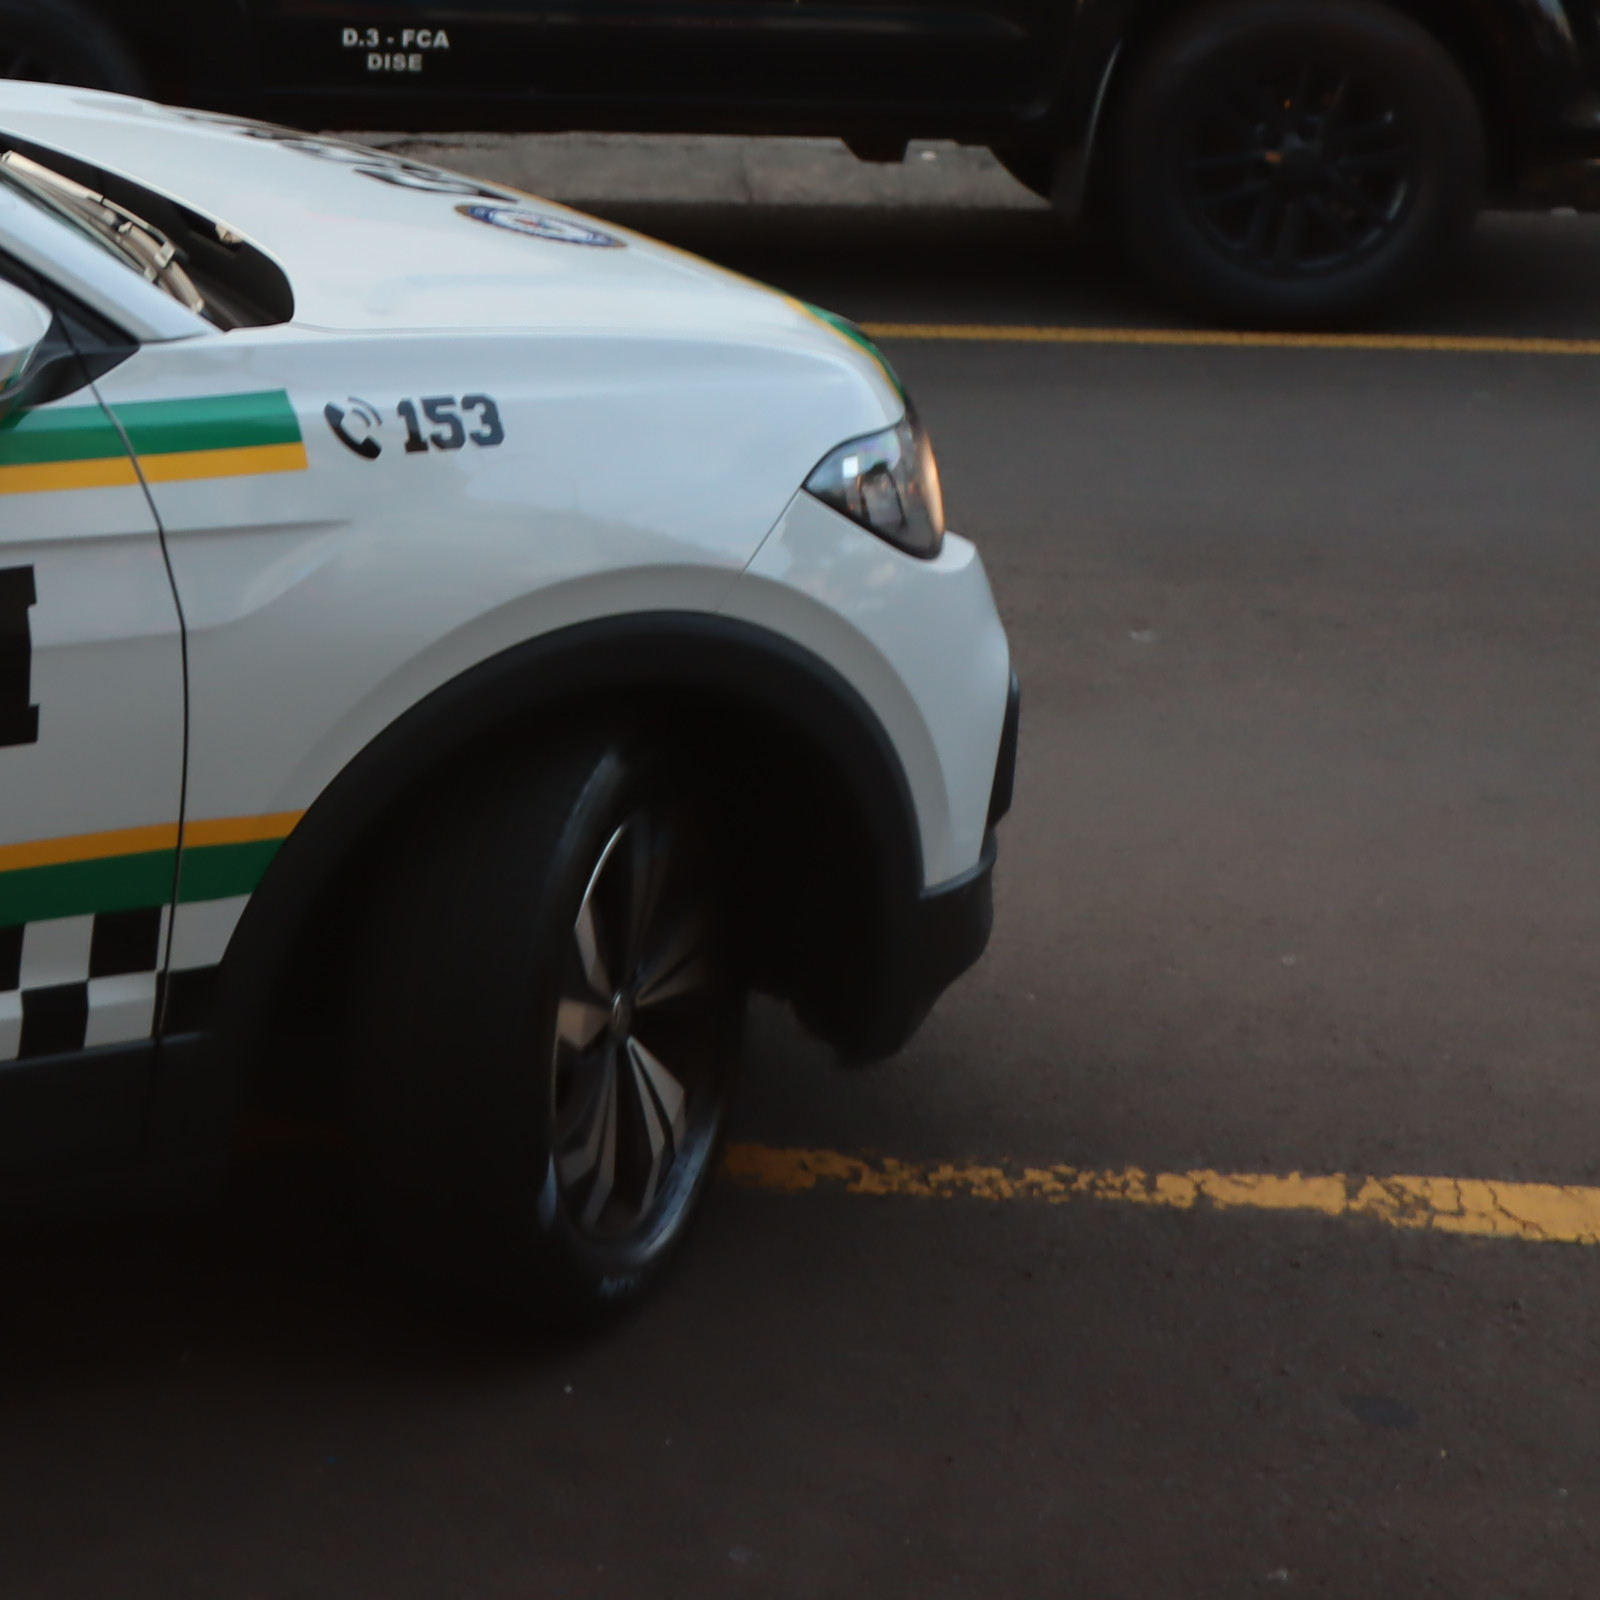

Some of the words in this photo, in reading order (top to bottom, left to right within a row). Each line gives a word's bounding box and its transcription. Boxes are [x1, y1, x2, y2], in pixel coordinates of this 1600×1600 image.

[402, 29, 450, 48] FCA
[368, 52, 423, 72] DISE
[396, 392, 505, 454] 153
